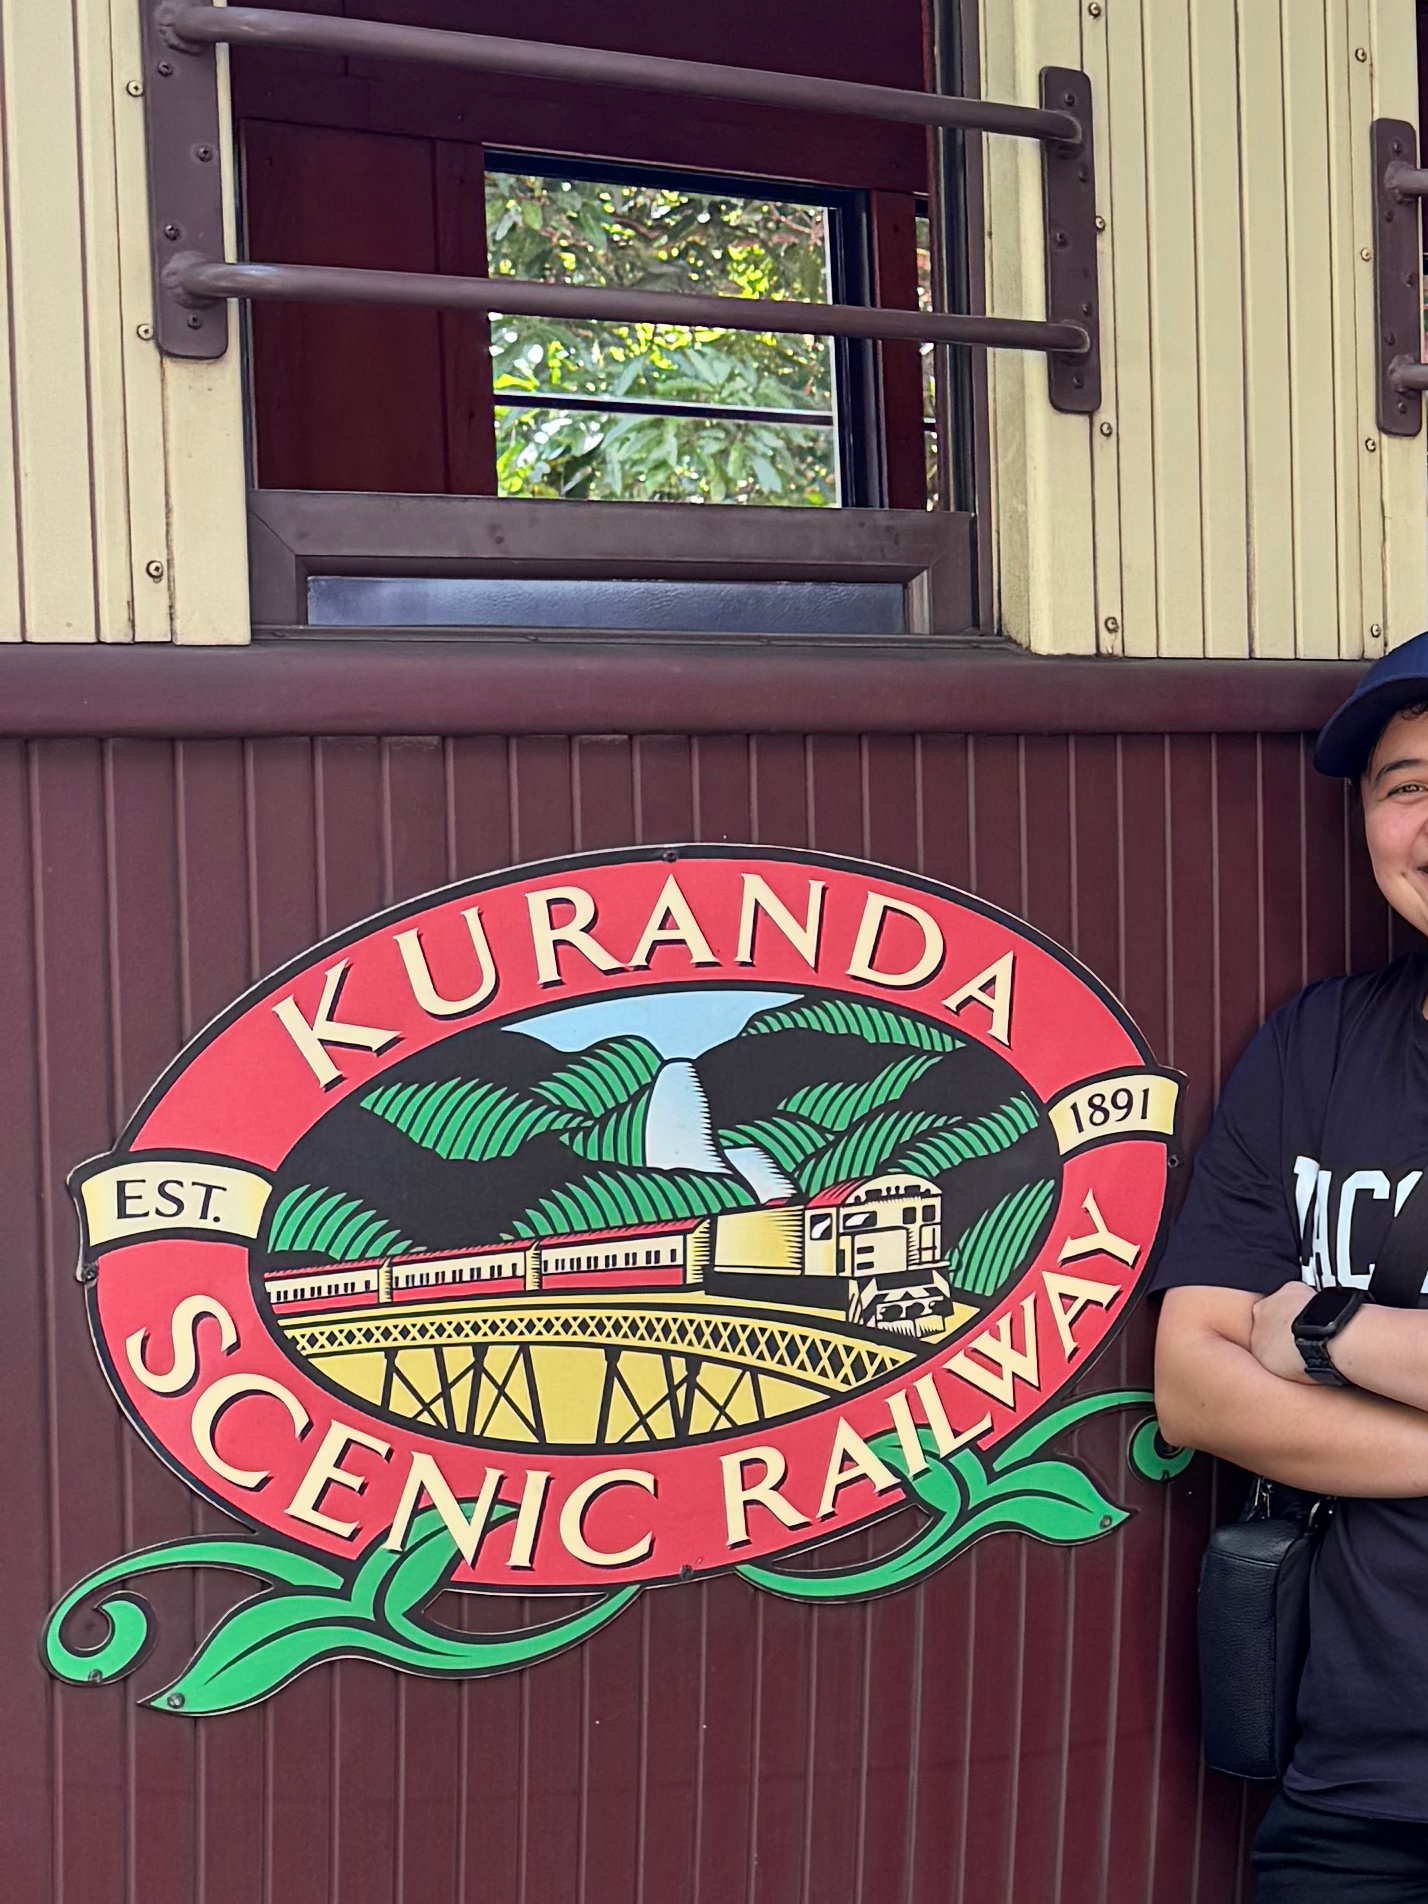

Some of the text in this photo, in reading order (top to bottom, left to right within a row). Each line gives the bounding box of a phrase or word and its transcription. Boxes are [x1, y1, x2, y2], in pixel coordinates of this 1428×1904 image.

[271, 872, 1018, 1093] KURANDA
[1066, 1088, 1153, 1130] 1891
[114, 1179, 224, 1226] EST.
[126, 1189, 1142, 1570] SCENIC RAILWAY
